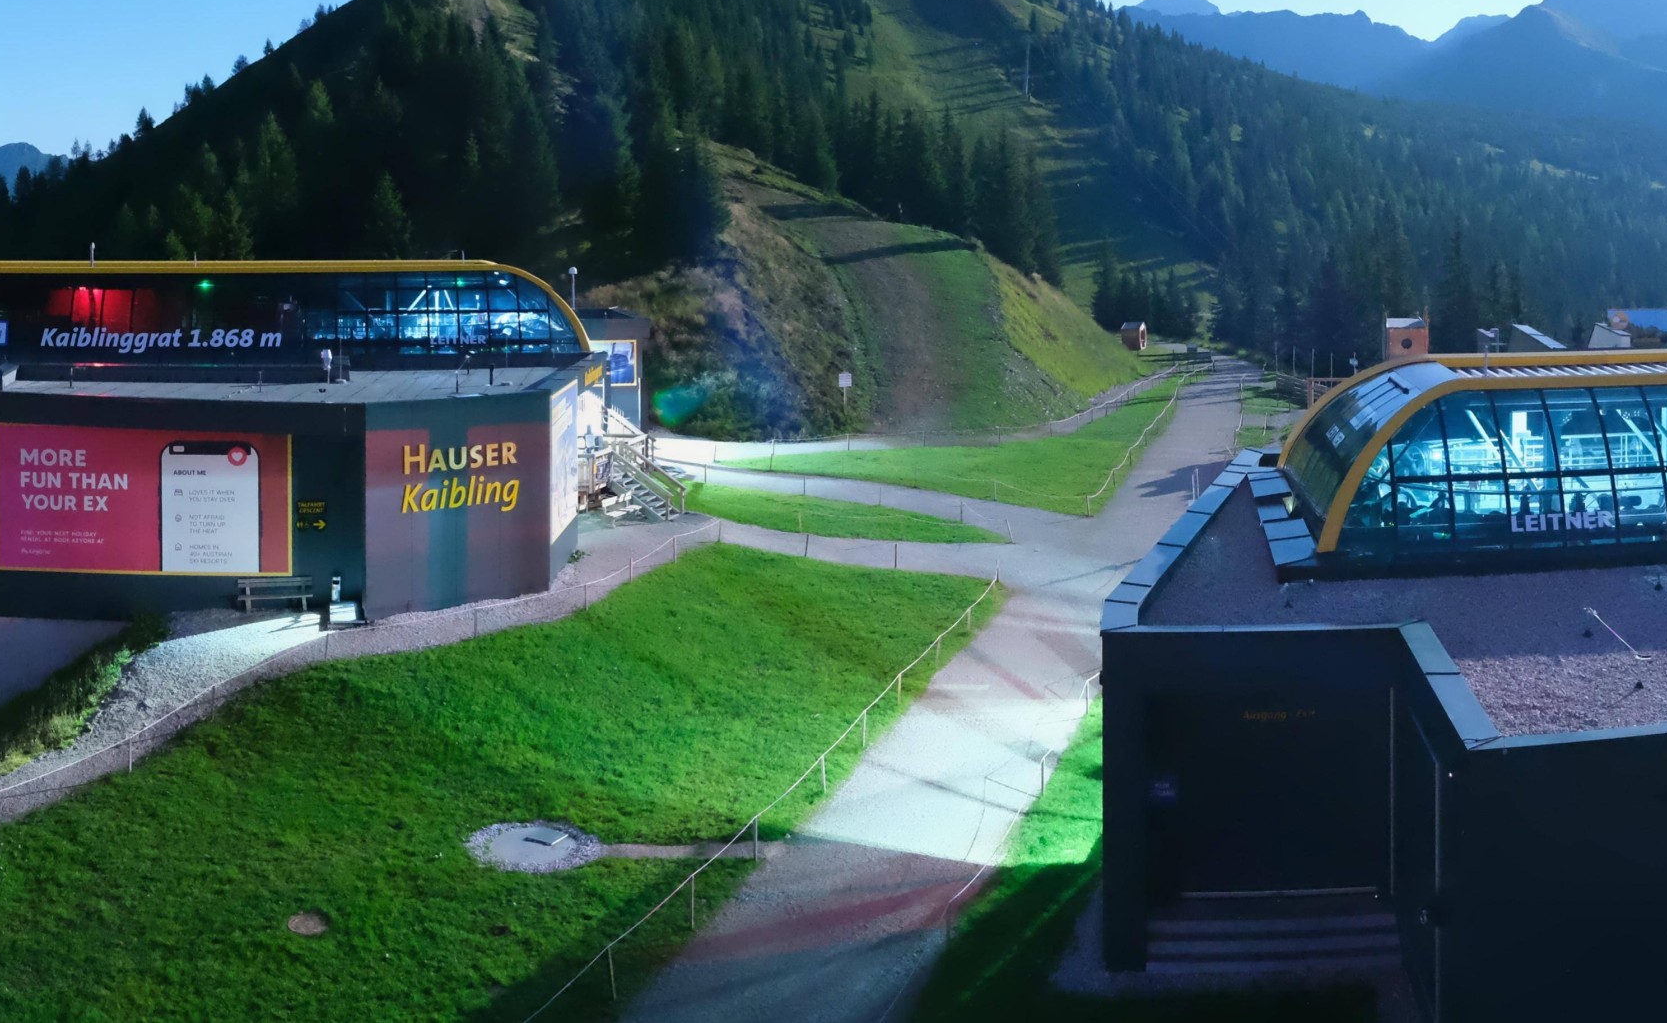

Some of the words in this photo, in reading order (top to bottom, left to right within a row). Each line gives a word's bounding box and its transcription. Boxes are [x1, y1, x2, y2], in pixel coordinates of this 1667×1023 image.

[40, 327, 183, 354] Kaiblinggrat
[187, 328, 255, 348] 1.868
[259, 331, 282, 348] m
[430, 335, 487, 345] LEITNER
[20, 448, 87, 467] MORE
[402, 441, 518, 475] HAUSER
[20, 471, 62, 488] FUN
[68, 473, 129, 490] THAN
[21, 494, 77, 511] YOUR
[83, 495, 109, 512] EX
[401, 475, 520, 514] Kaibling
[1510, 510, 1614, 533] LEITNER
